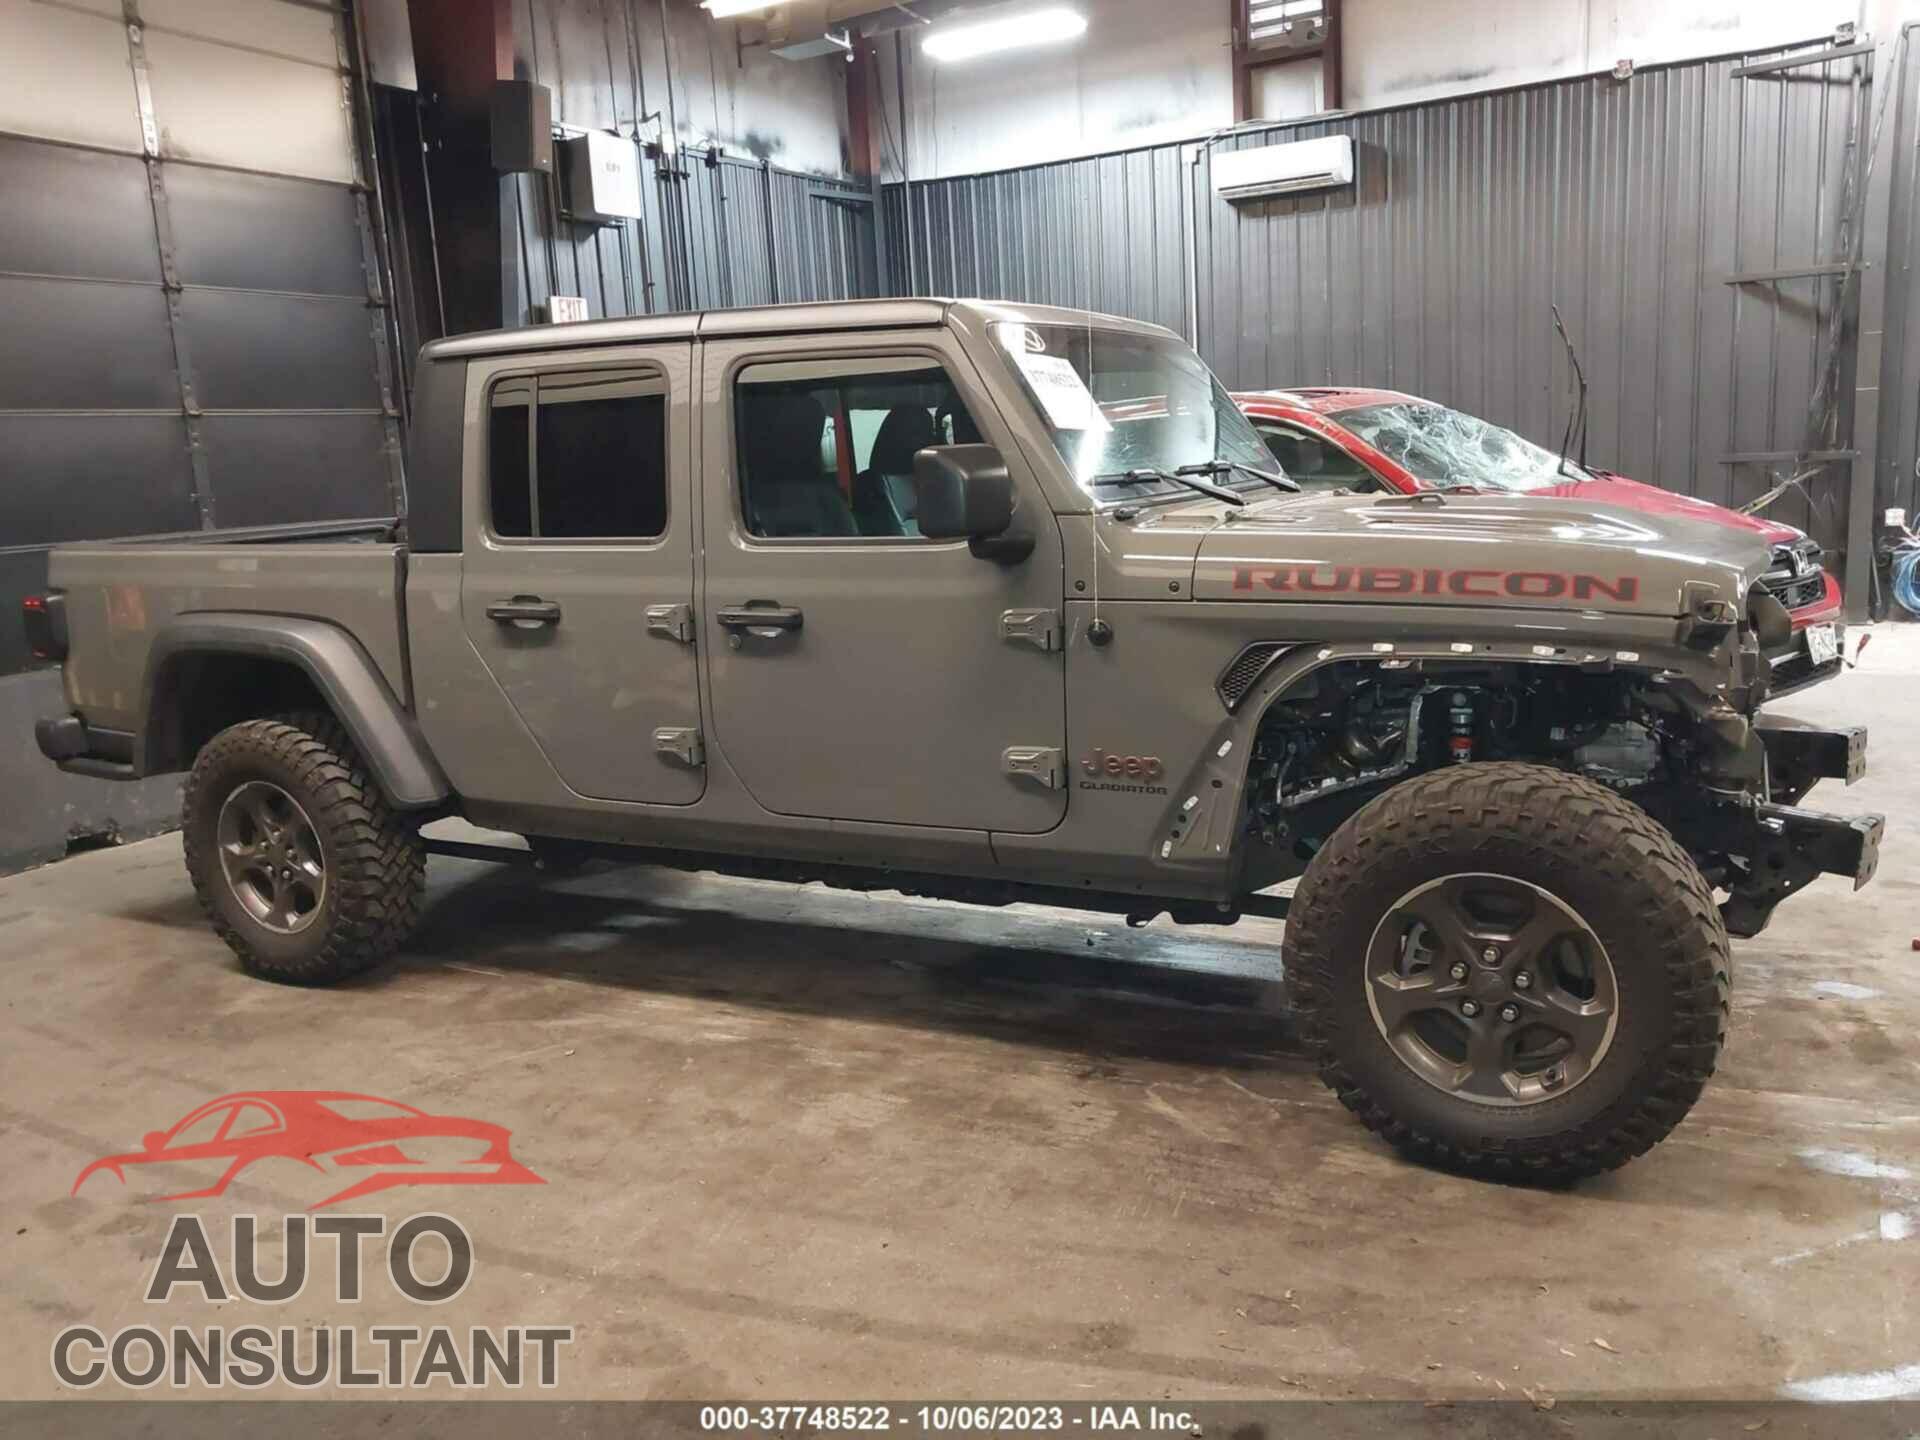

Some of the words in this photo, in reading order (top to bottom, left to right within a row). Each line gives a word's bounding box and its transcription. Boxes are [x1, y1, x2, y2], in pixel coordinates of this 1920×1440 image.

[558, 298, 584, 321] EXIT
[1232, 567, 1640, 602] RUBICON
[1080, 747, 1162, 780] Jeep
[1079, 781, 1168, 796] GLADIATOR
